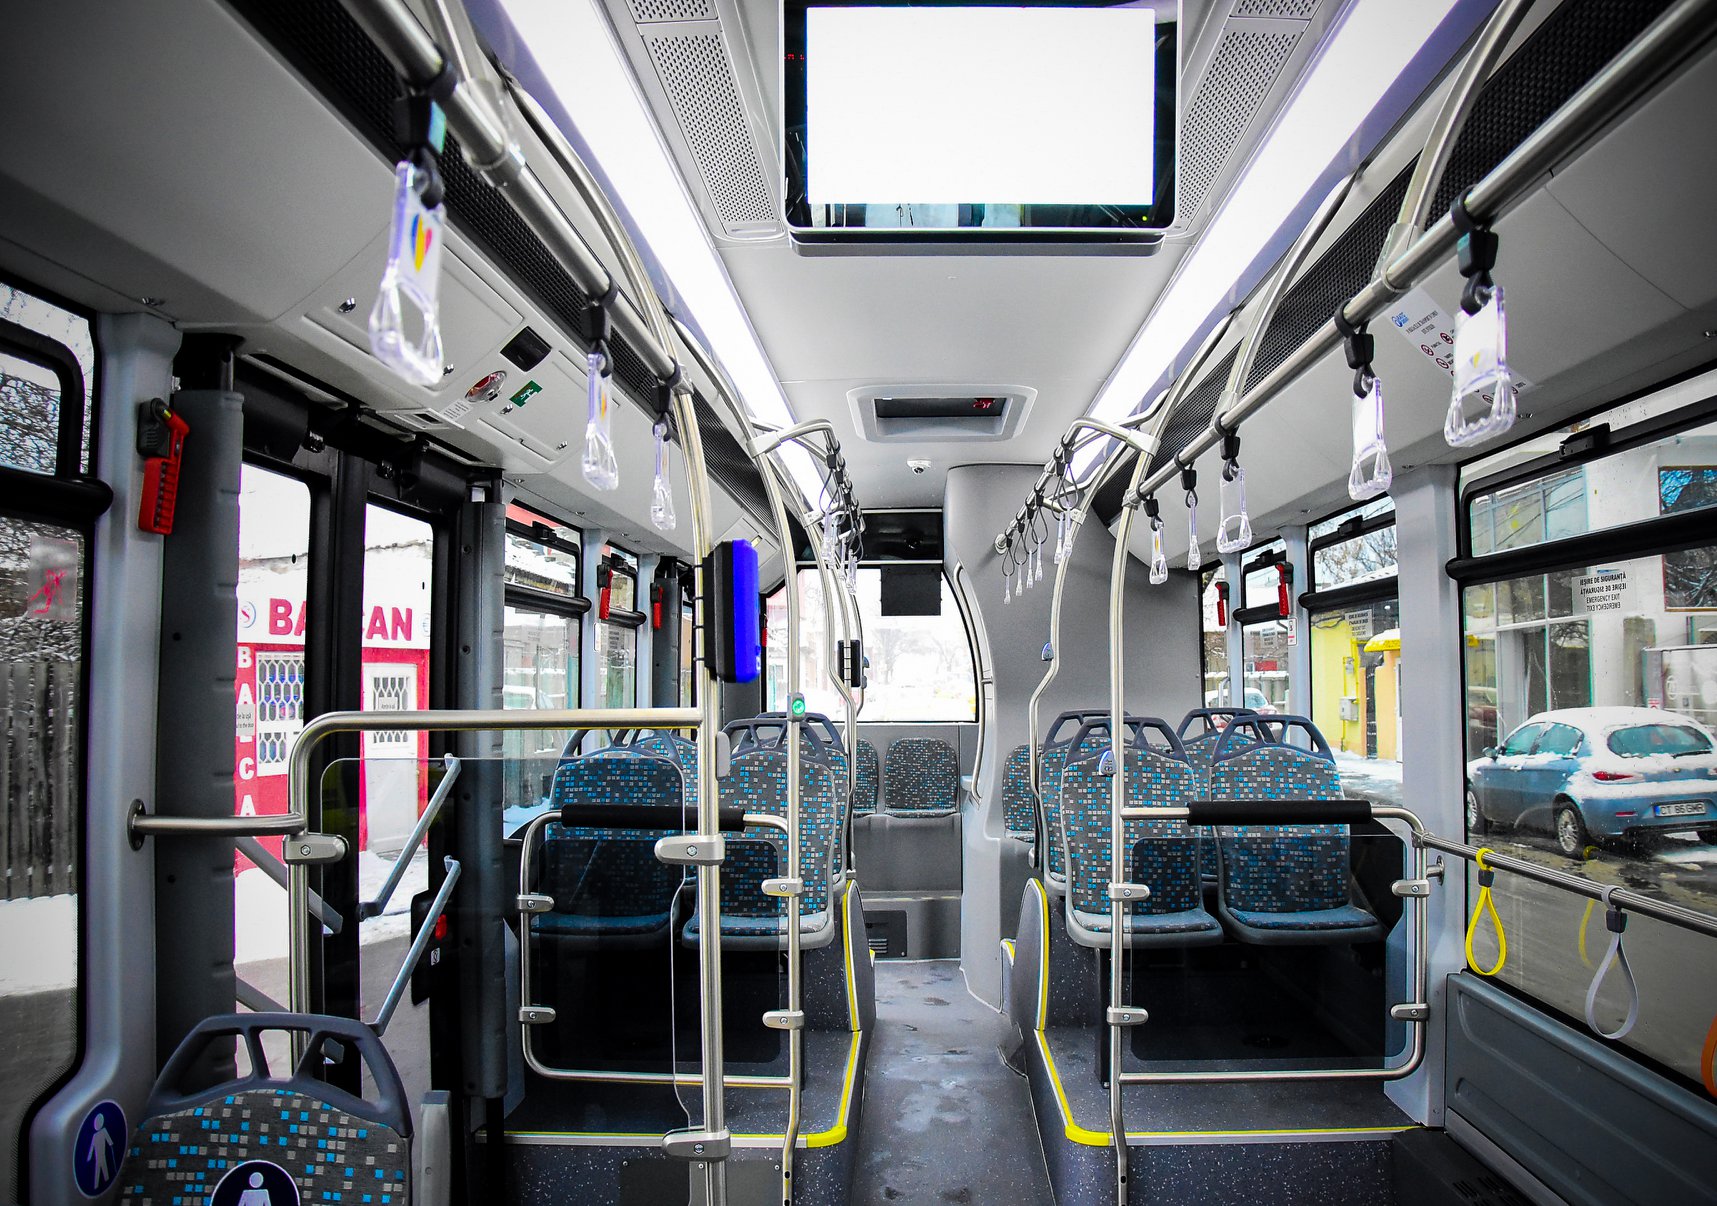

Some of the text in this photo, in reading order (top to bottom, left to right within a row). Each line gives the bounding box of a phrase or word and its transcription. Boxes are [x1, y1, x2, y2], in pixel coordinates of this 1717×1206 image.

[1587, 593, 1620, 603] EMERGENCY EXIT
[1661, 805, 1671, 815] CT
